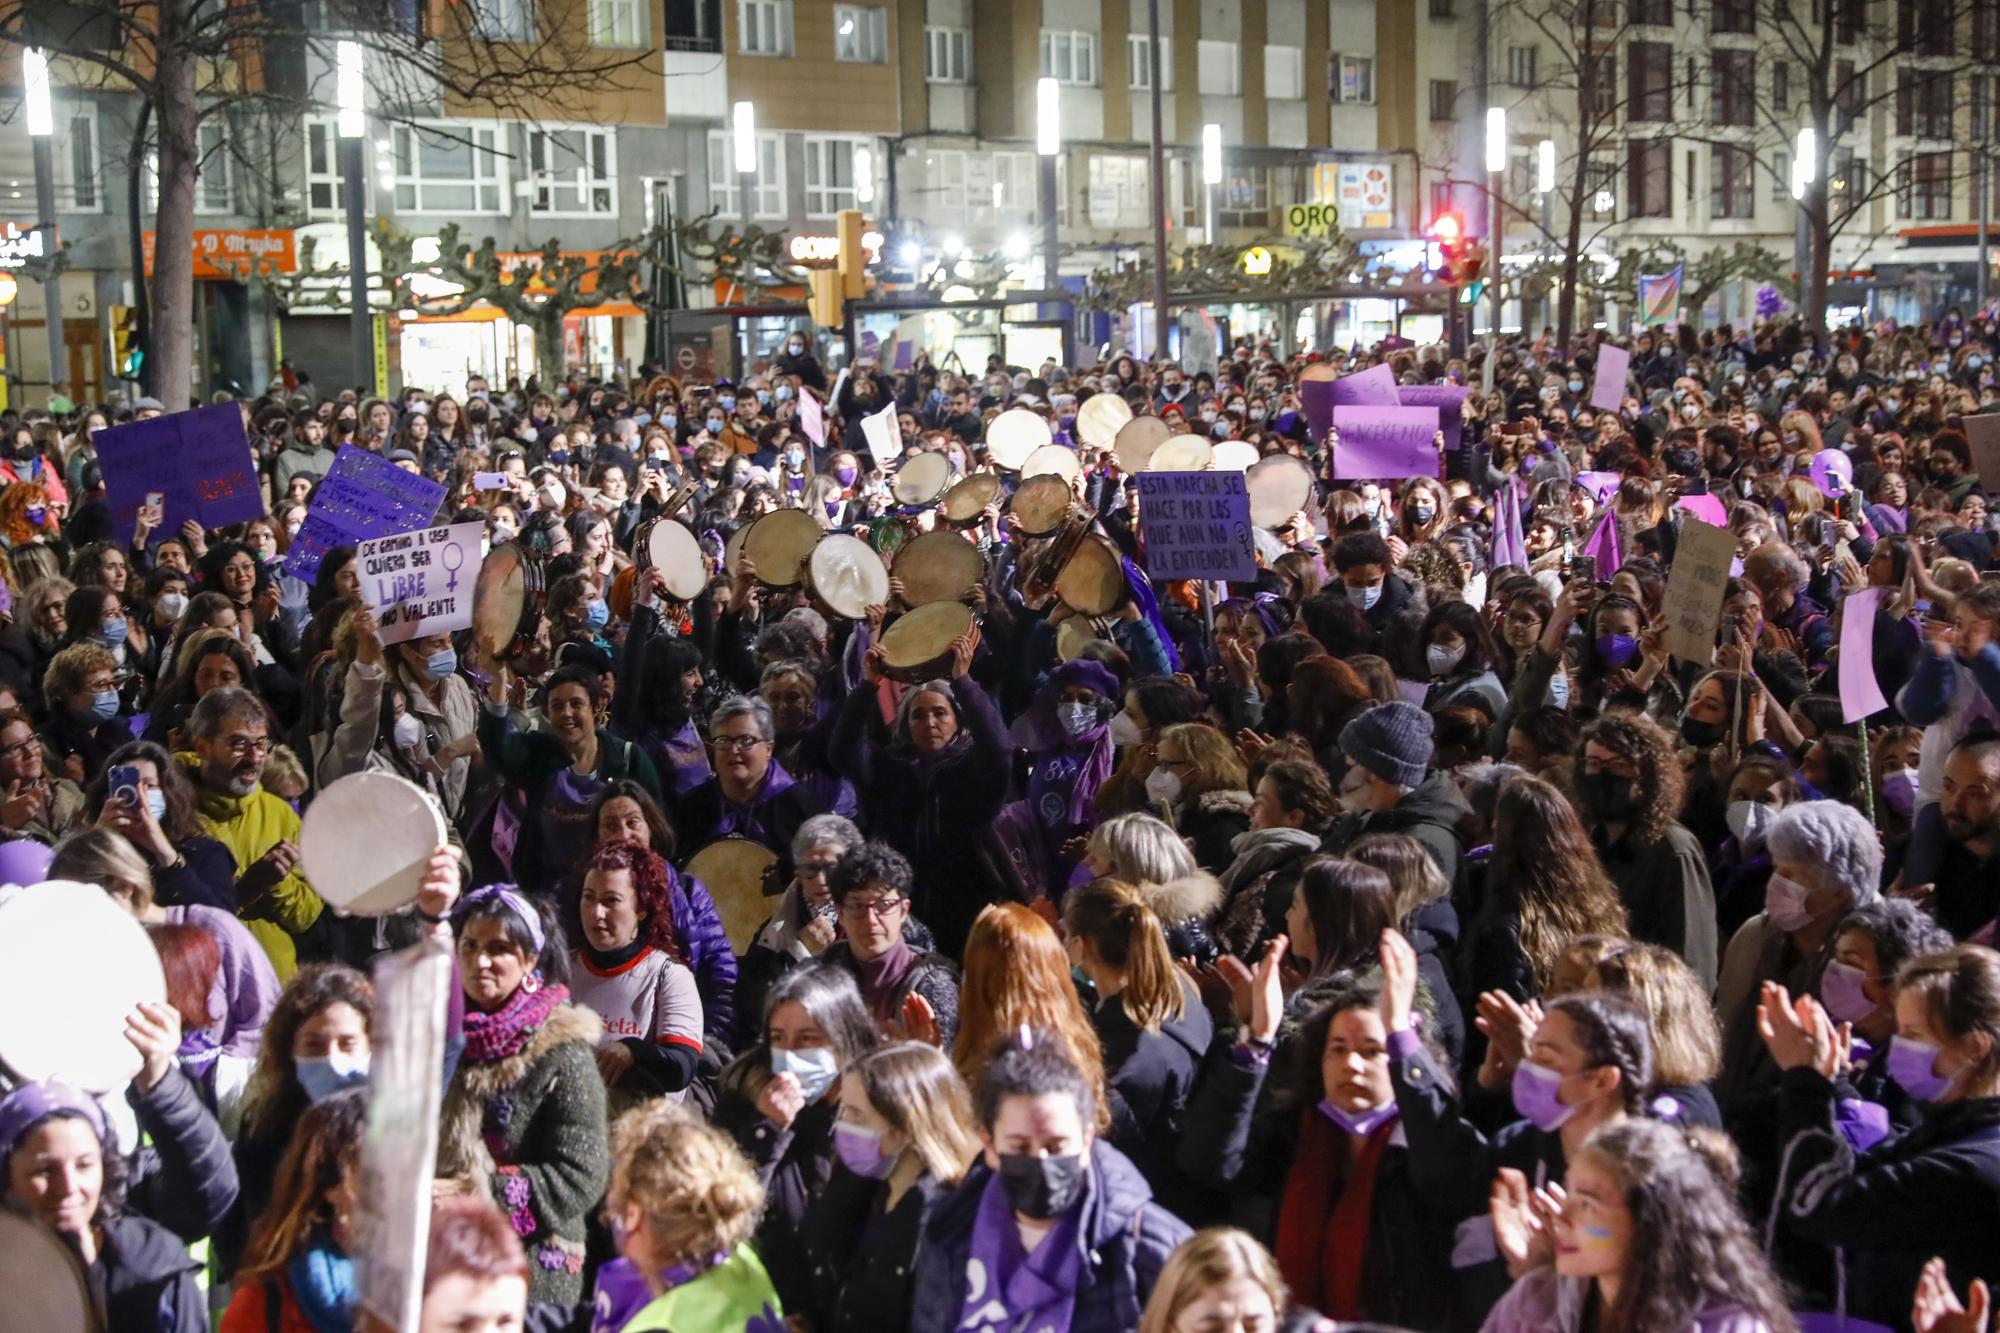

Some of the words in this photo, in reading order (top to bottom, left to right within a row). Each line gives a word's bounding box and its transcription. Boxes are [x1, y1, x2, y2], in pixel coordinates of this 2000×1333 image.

[1290, 205, 1339, 228] ORO
[1140, 476, 1169, 495] ESTA
[1175, 475, 1218, 495] MARCHA
[1224, 475, 1241, 495] SE
[1145, 500, 1177, 519] HACE
[1183, 500, 1205, 519] POR
[1209, 499, 1231, 519] LOS
[363, 541, 375, 558] DE
[419, 532, 425, 546] A
[429, 528, 449, 543] CASA
[1148, 524, 1173, 545] QUE
[1179, 523, 1204, 545] AUN
[1208, 523, 1228, 544] NO
[411, 550, 432, 568] SER
[1153, 550, 1168, 571] LA
[381, 609, 397, 628] NO
